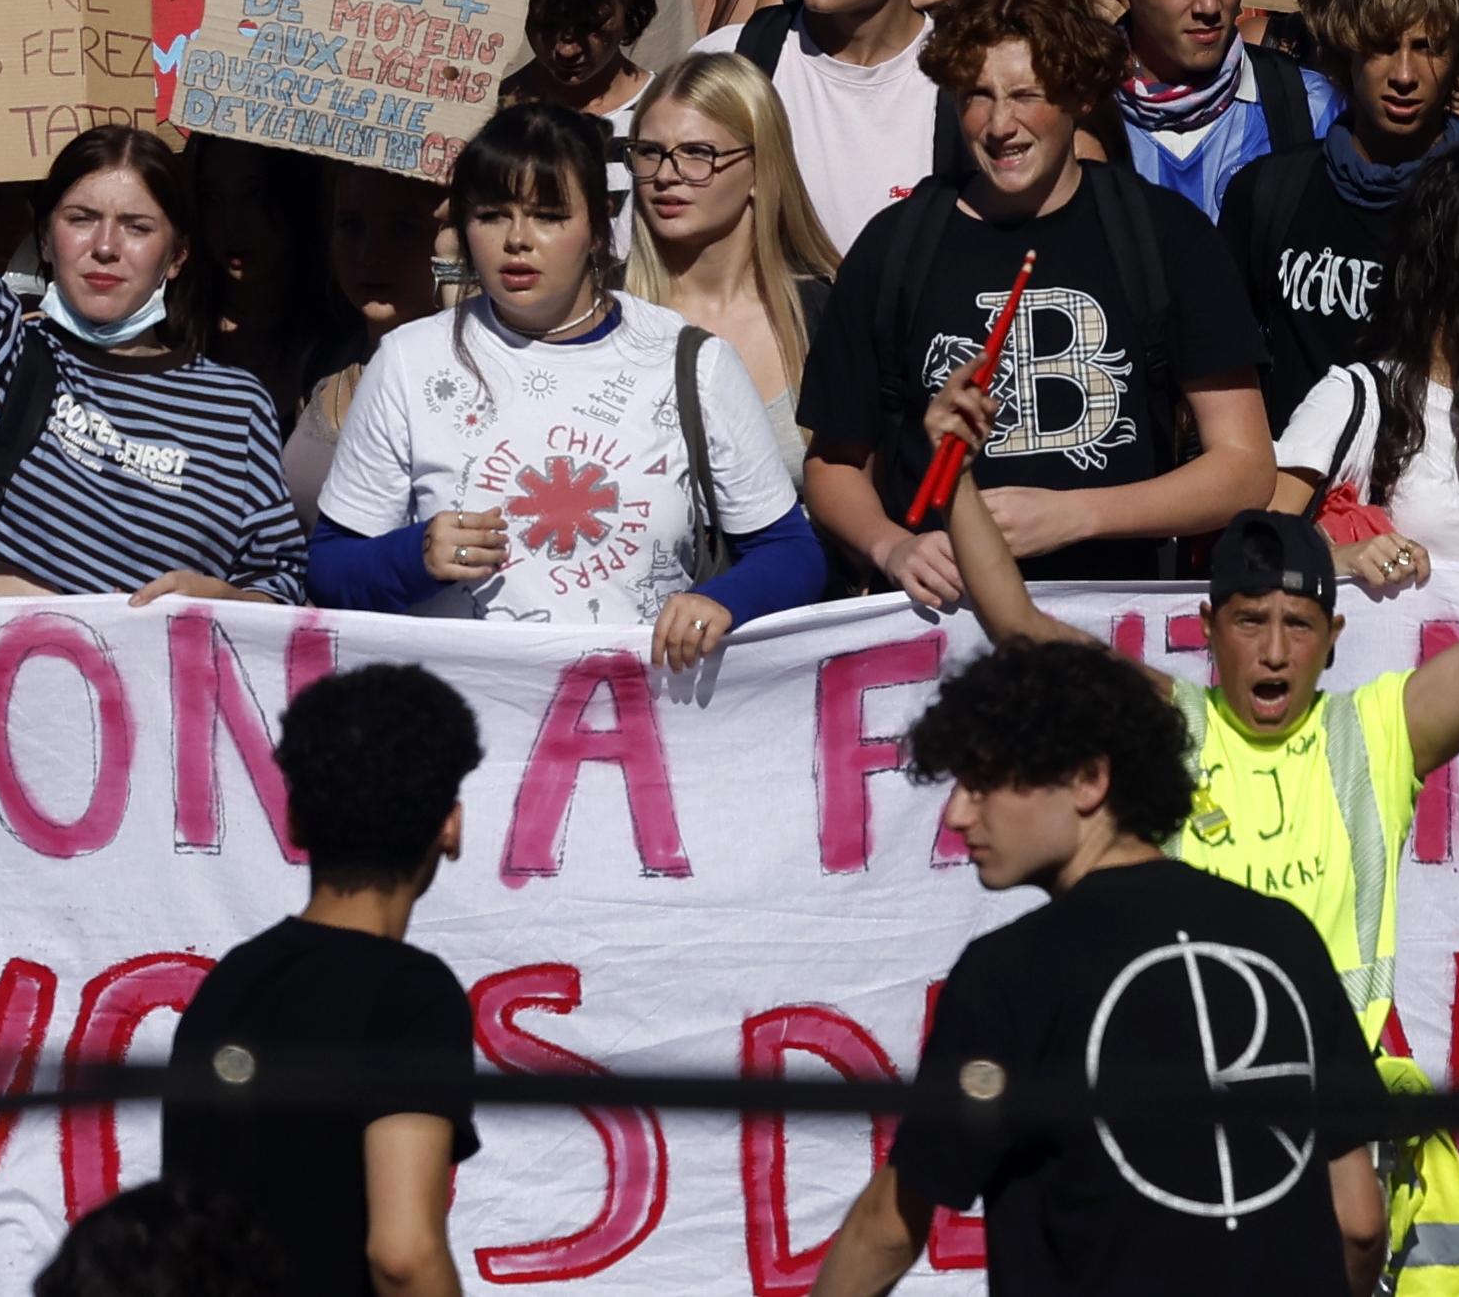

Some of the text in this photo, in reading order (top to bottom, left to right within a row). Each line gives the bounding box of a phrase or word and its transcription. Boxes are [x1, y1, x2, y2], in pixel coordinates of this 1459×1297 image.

[124, 440, 190, 475] FIRST
[546, 425, 632, 471] CHILI
[548, 500, 652, 595] PEPPERS
[500, 647, 692, 888] A
